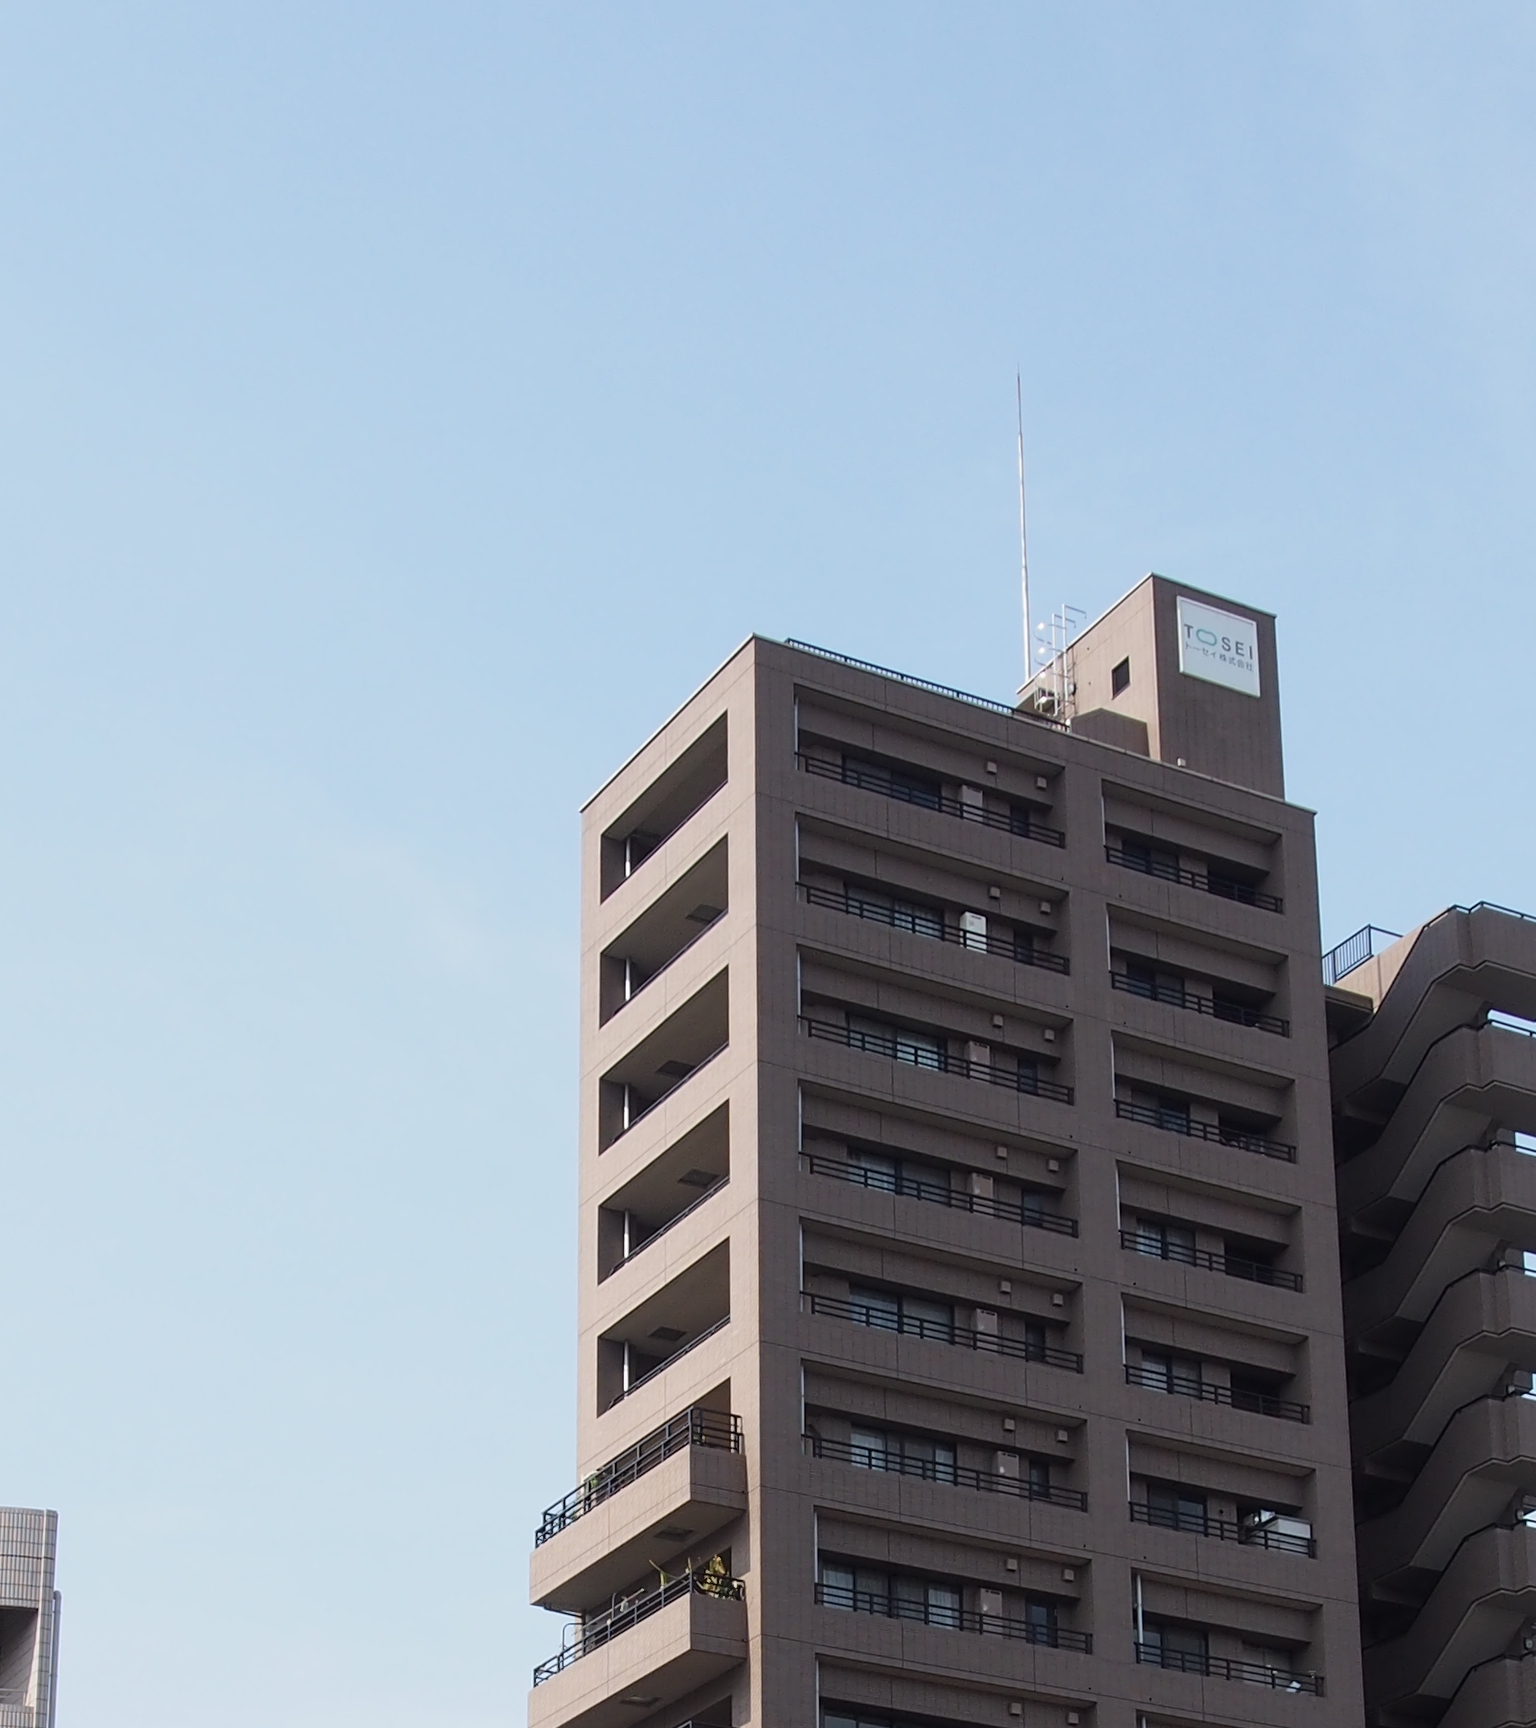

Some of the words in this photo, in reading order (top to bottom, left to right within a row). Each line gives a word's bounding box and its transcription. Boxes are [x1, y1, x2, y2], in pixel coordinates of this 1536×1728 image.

[1183, 623, 1253, 660] TOSEI
[1185, 641, 1253, 672] トーセイ株式会社
